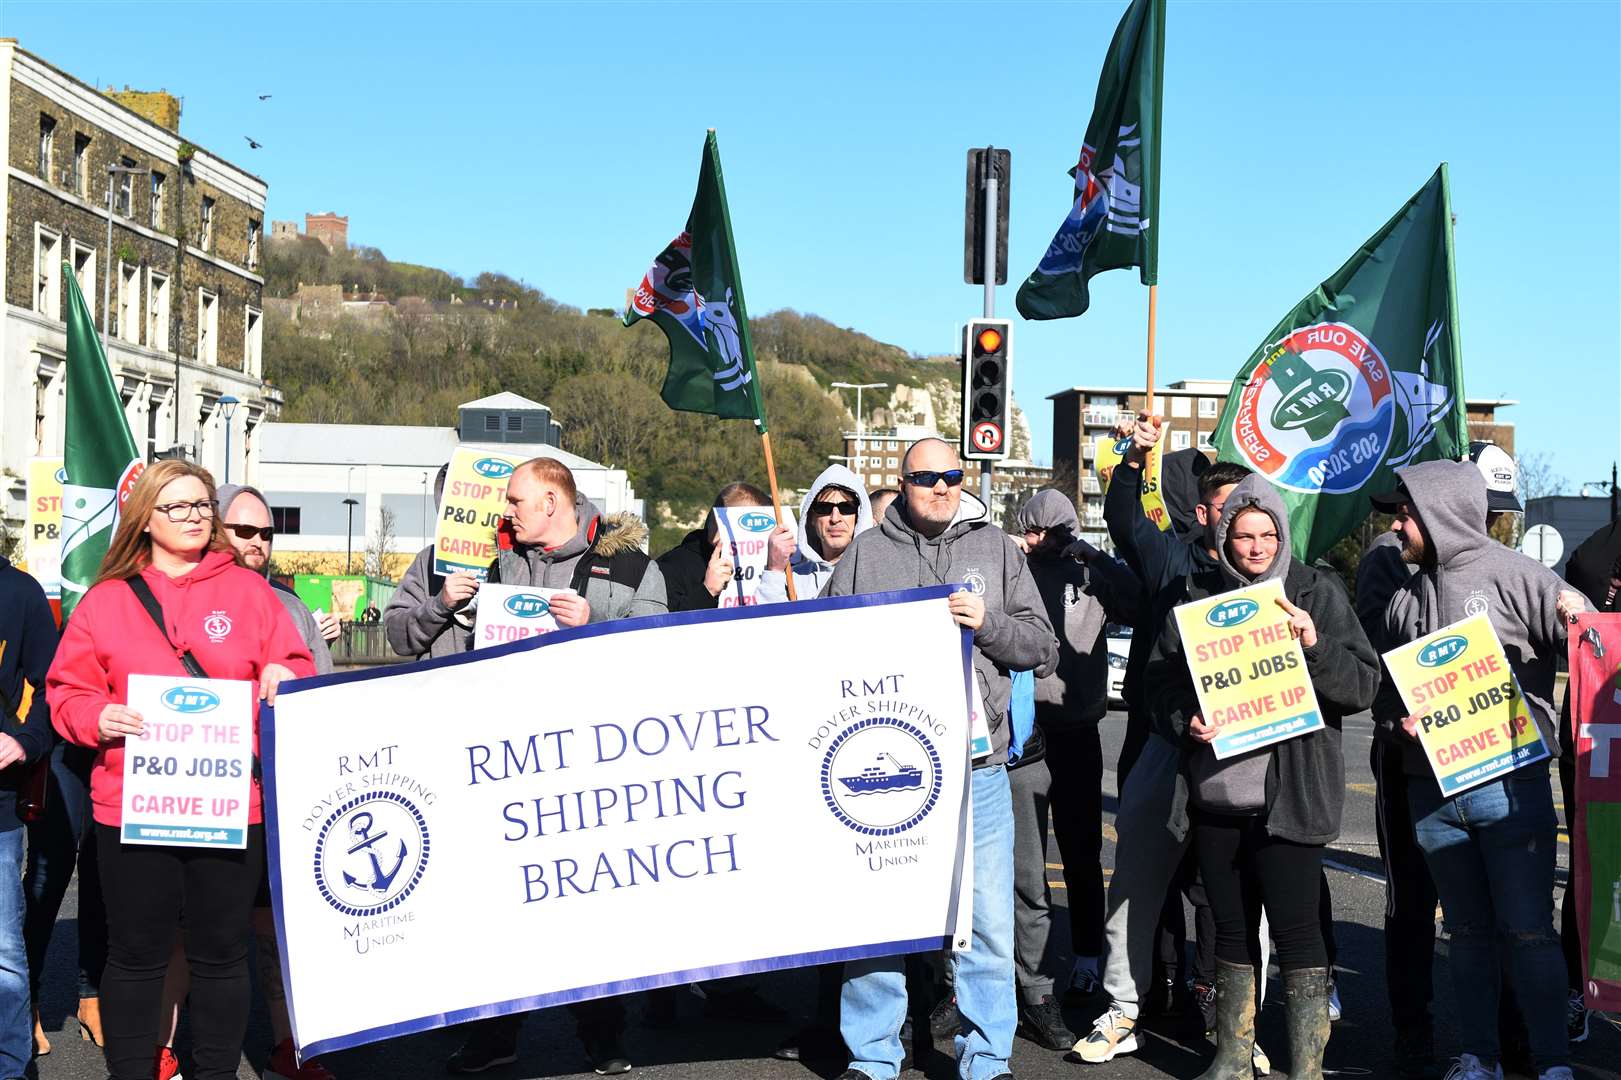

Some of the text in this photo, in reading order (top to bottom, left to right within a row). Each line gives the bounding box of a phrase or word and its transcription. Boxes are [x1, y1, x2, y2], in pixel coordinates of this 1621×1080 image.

[481, 463, 509, 474] RMT
[1100, 464, 1115, 483] ST
[451, 480, 492, 500] STOP
[36, 496, 63, 512] ST
[443, 505, 501, 529] P&O JO
[747, 518, 769, 527] RMT
[34, 523, 60, 540] P&
[440, 536, 492, 559] CARVE
[728, 540, 765, 556] STOP
[733, 565, 754, 581] &O
[514, 601, 543, 612] RMT
[1218, 604, 1249, 621] RMT
[485, 624, 530, 641] STOP
[1196, 622, 1287, 662] STOP THE
[1428, 641, 1457, 662] RMT
[1200, 651, 1299, 693] P&O JOBS
[1411, 654, 1501, 704] STOP THE
[841, 674, 904, 698] RMT
[173, 694, 209, 706] RMT
[1212, 686, 1306, 727] CARVE UP
[1420, 682, 1516, 733] P&O JOBS
[138, 722, 241, 744] STOP THE
[808, 700, 947, 749] DOVER SHIPPING
[465, 705, 781, 786] RMT DOVER
[1435, 715, 1529, 767] CARVE UP
[132, 755, 242, 778] P&O JOBS
[338, 745, 398, 776] RMT
[1455, 747, 1531, 784] www.rmt.org.uk
[131, 794, 240, 817] CARVE UP
[302, 772, 438, 832] DOVER SHIPPING
[502, 770, 748, 842] SHIPPING
[519, 833, 742, 904] BRANCH
